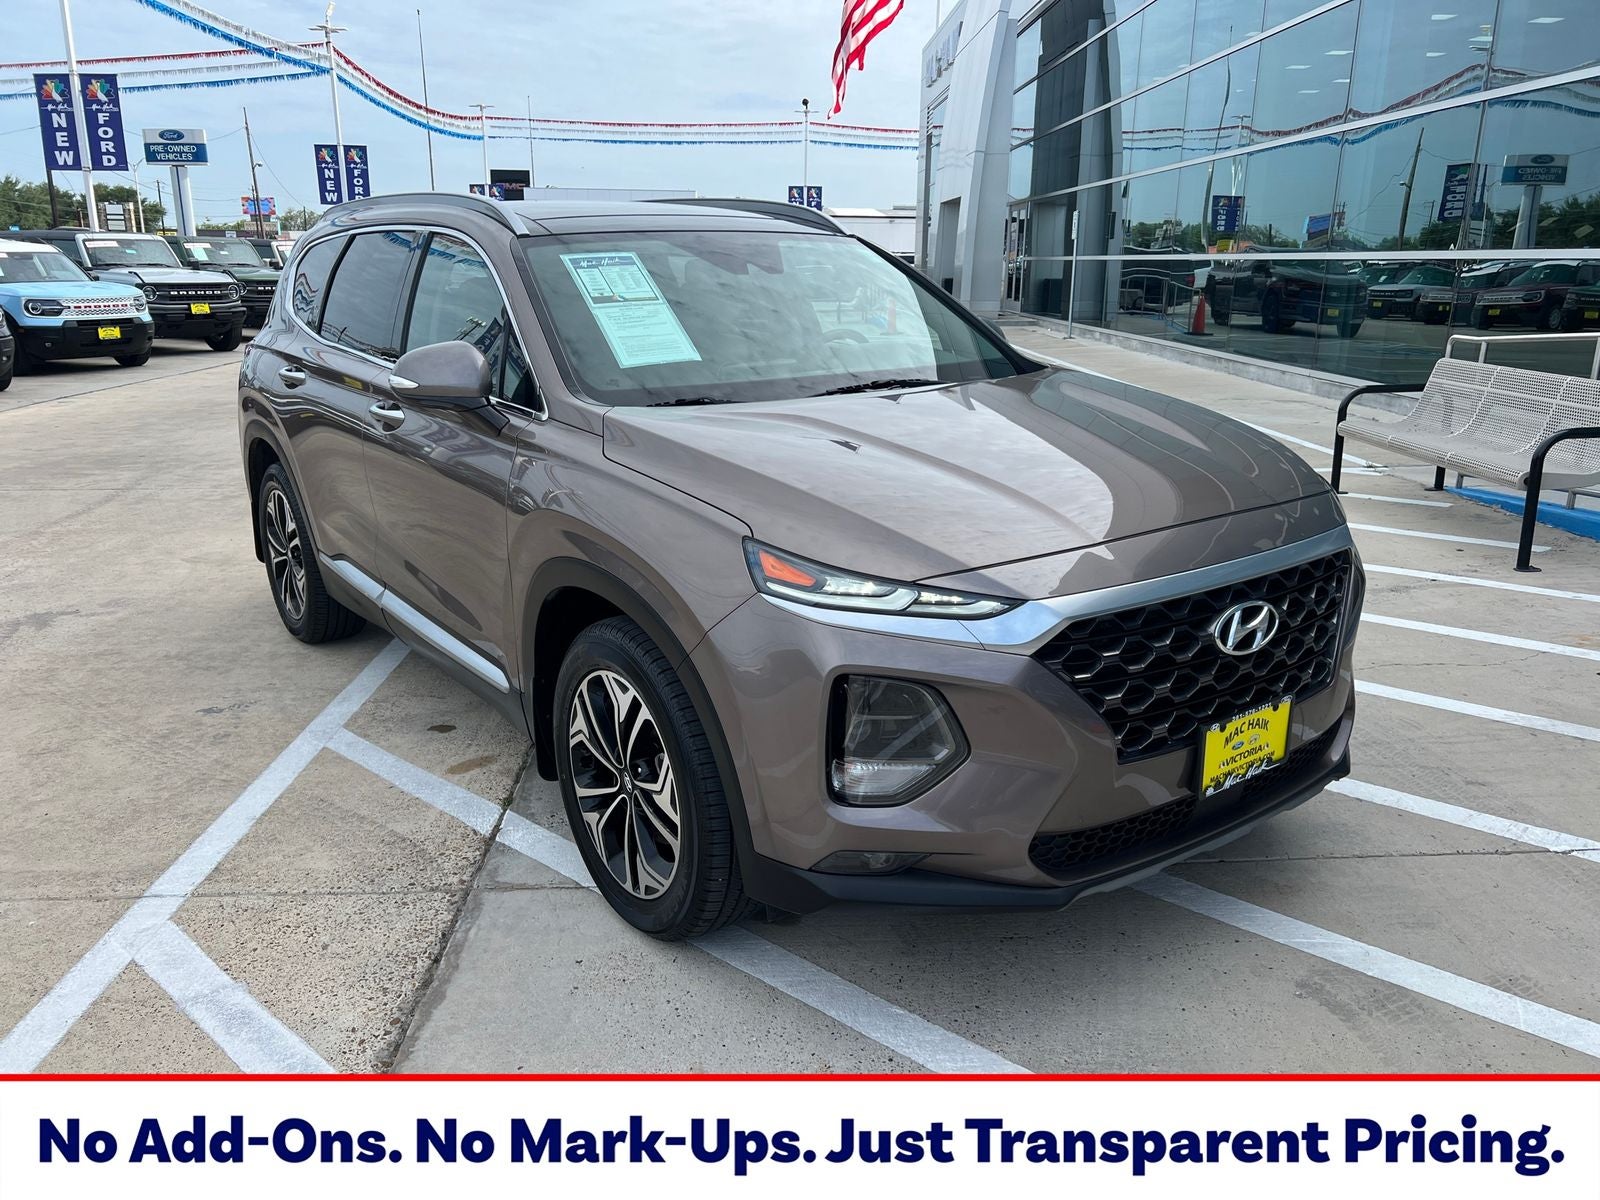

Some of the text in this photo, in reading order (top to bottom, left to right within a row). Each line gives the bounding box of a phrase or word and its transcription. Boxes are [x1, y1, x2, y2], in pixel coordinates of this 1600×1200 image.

[51, 112, 74, 166] NEW
[97, 112, 117, 167] FORD
[150, 144, 197, 152] PRE-OWNED
[156, 152, 193, 161] VEHICLES
[323, 168, 338, 202] NEW
[1223, 721, 1246, 749] MAC
[1247, 717, 1269, 732] HAIK
[1225, 744, 1262, 767] VICTORIA
[1223, 759, 1273, 790] Mac Haik
